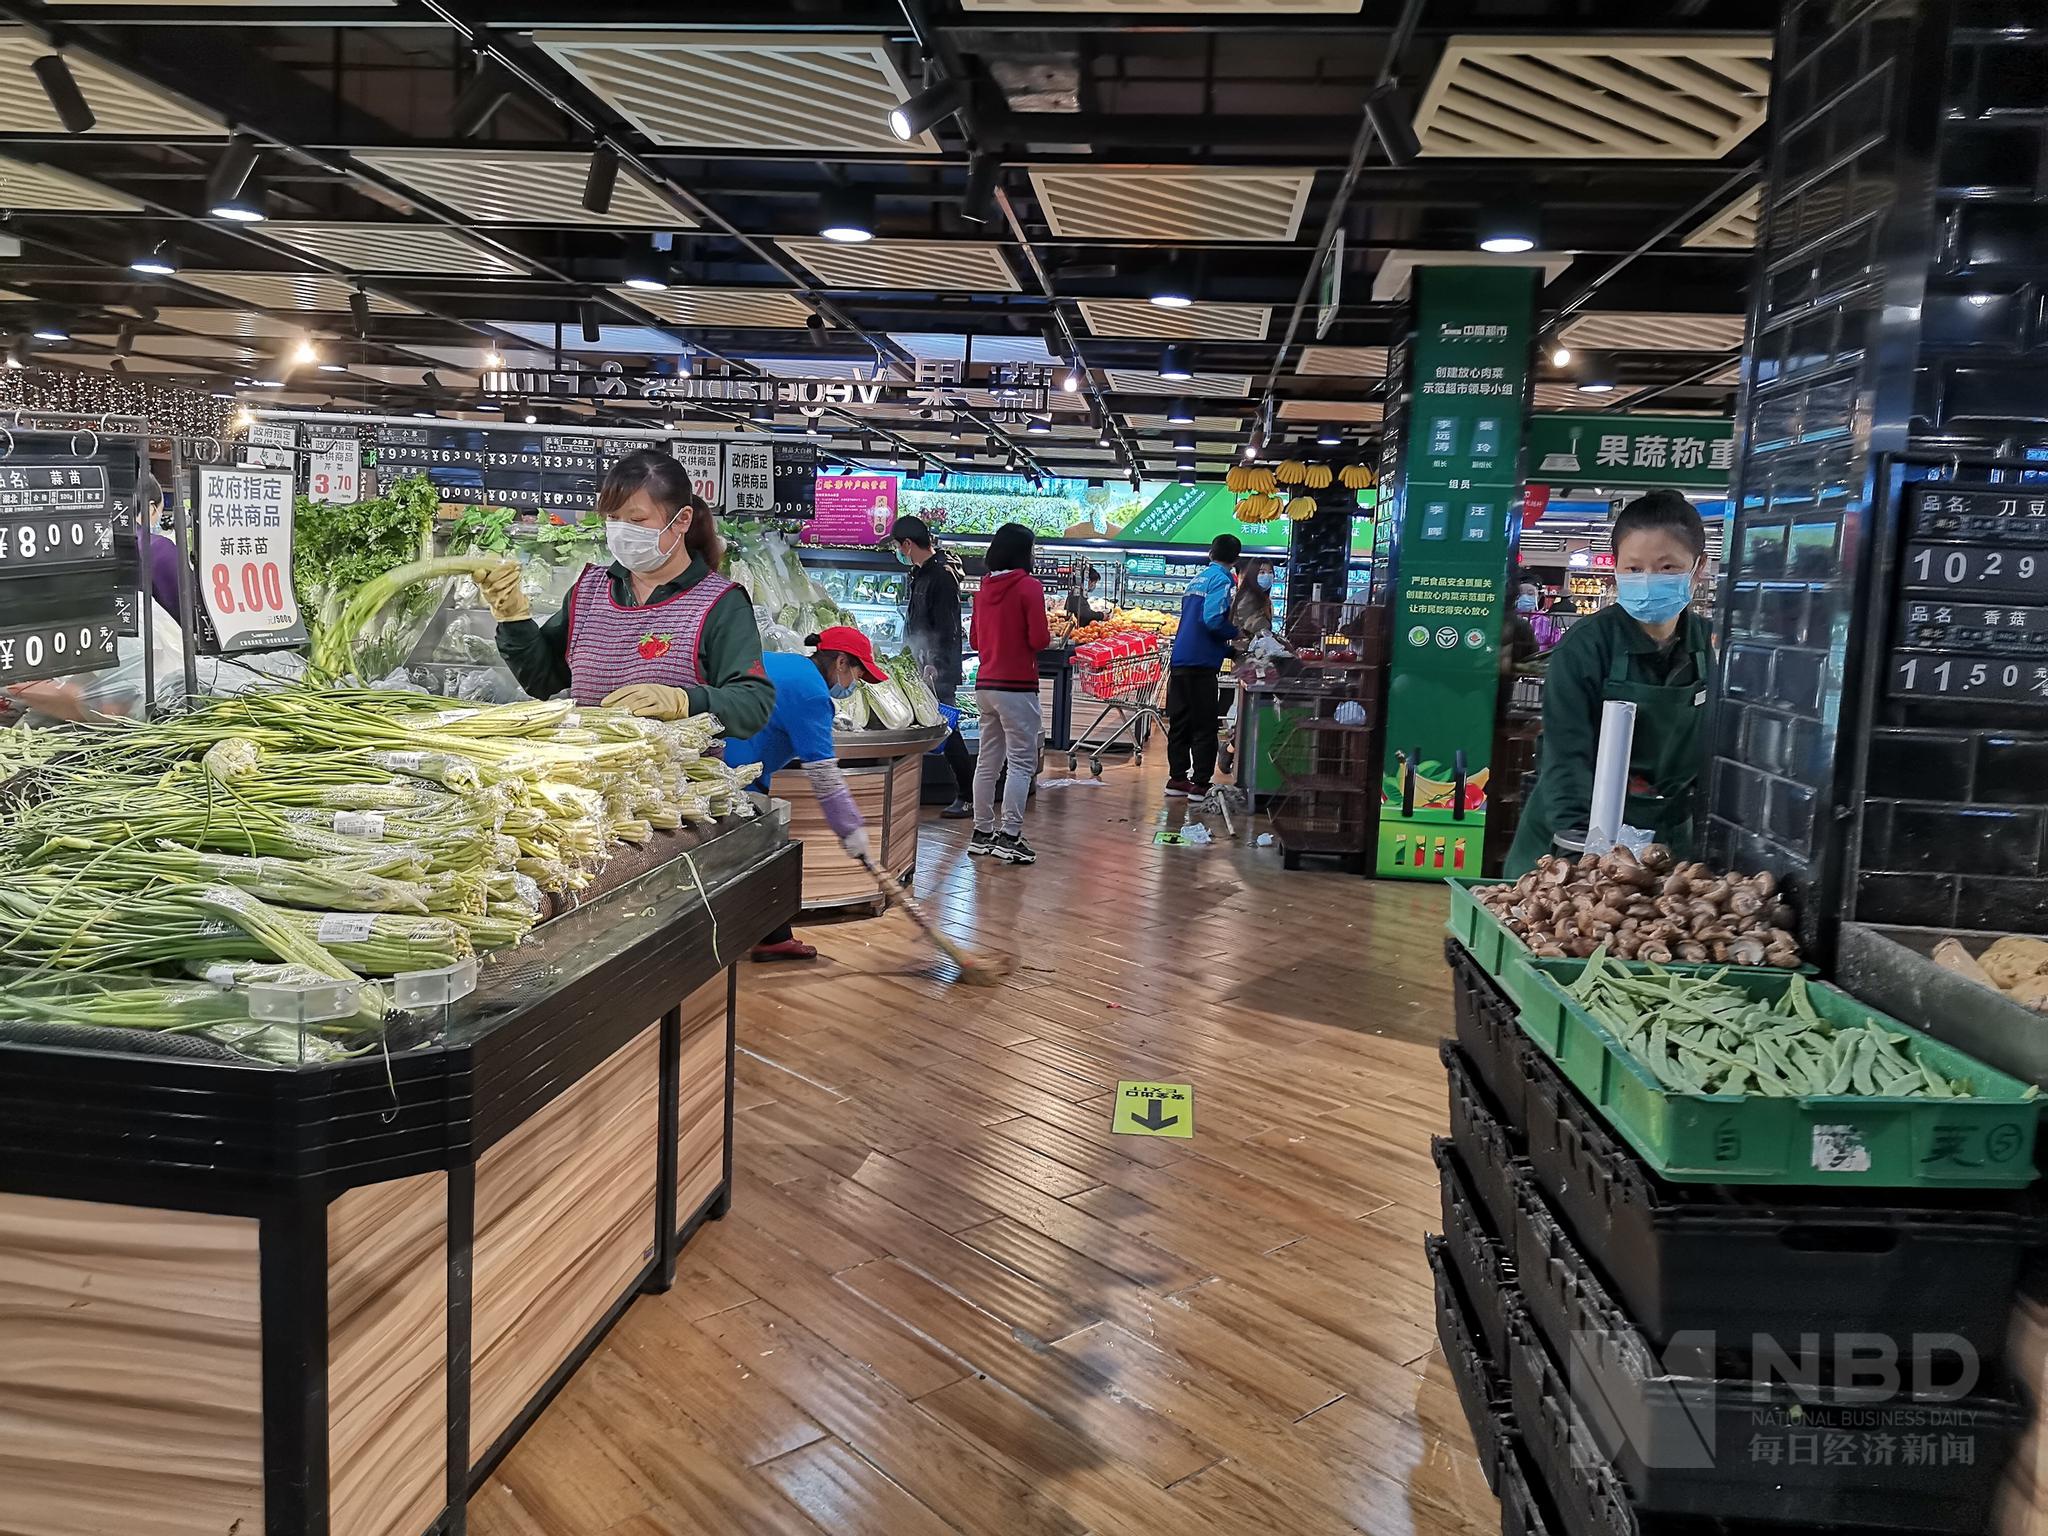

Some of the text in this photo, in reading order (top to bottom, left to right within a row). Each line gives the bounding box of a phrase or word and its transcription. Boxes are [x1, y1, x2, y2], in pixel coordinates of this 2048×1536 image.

[1435, 366, 1504, 379] 创建放心肉菜
[1422, 382, 1513, 396] 示范超市领导小组
[677, 444, 716, 456] 政府指定
[1595, 434, 1736, 470] 果蔬称重
[678, 456, 717, 467] 保供商品
[731, 453, 768, 470] 政府指定
[49, 469, 81, 486] 蒜苗
[687, 469, 708, 478] 上海青
[731, 472, 768, 490] 保供商品
[207, 475, 282, 502] 政府指定
[315, 473, 352, 495] 3.70
[736, 492, 764, 509] 售卖处
[1997, 500, 2047, 517] 刀豆
[207, 503, 280, 528] 保供商品
[1240, 523, 1269, 535] 无污染
[219, 537, 269, 556] 新蒜苗
[1912, 549, 2036, 584] 10.29
[212, 561, 284, 615] 8.00
[1411, 576, 1493, 588] 严把食品安全质量关
[1406, 590, 1496, 603] 创建放心肉菜示范超市
[1409, 604, 1490, 616] 让市民吃得安心放心
[1983, 610, 2028, 627] 香菇
[1899, 658, 2019, 692] 11.50
